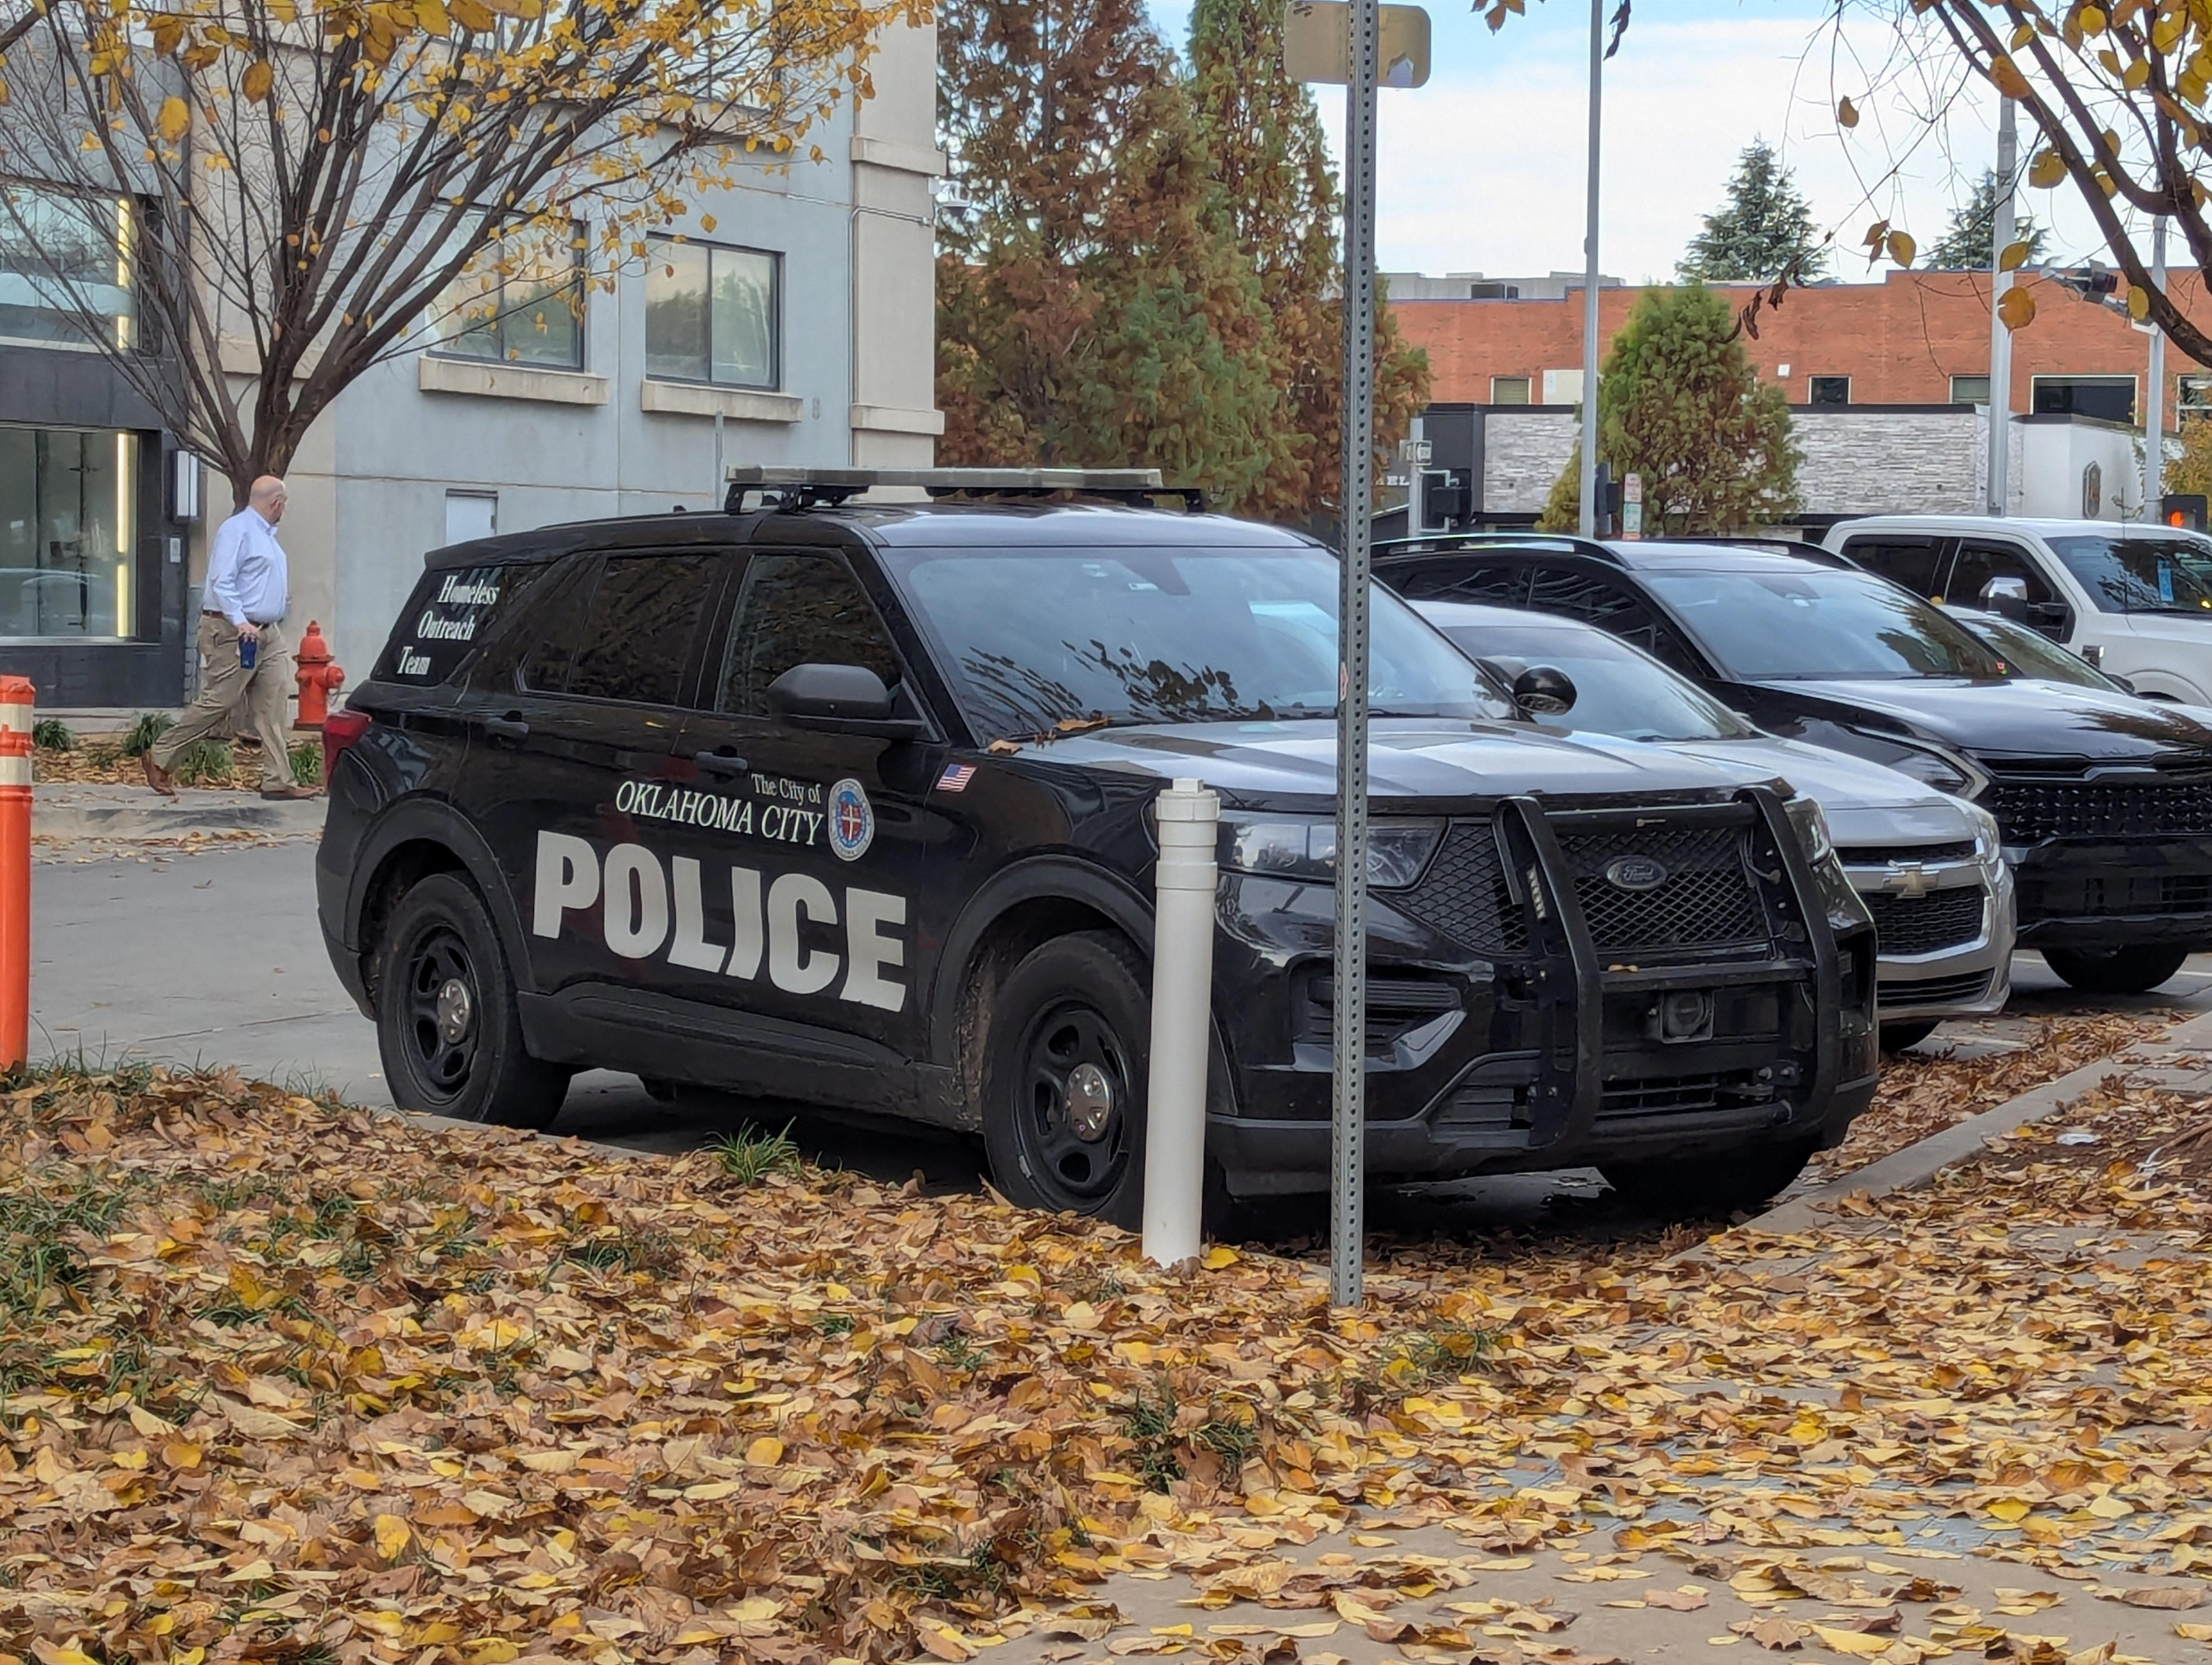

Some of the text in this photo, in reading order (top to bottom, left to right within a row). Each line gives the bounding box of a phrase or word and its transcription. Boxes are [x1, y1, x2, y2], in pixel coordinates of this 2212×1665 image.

[417, 610, 476, 641] Outreach
[397, 646, 431, 675] Team
[751, 774, 822, 806] The City of
[616, 781, 753, 834] OKLAHOMA
[761, 805, 824, 845] CITY
[533, 830, 906, 1012] POLICE
